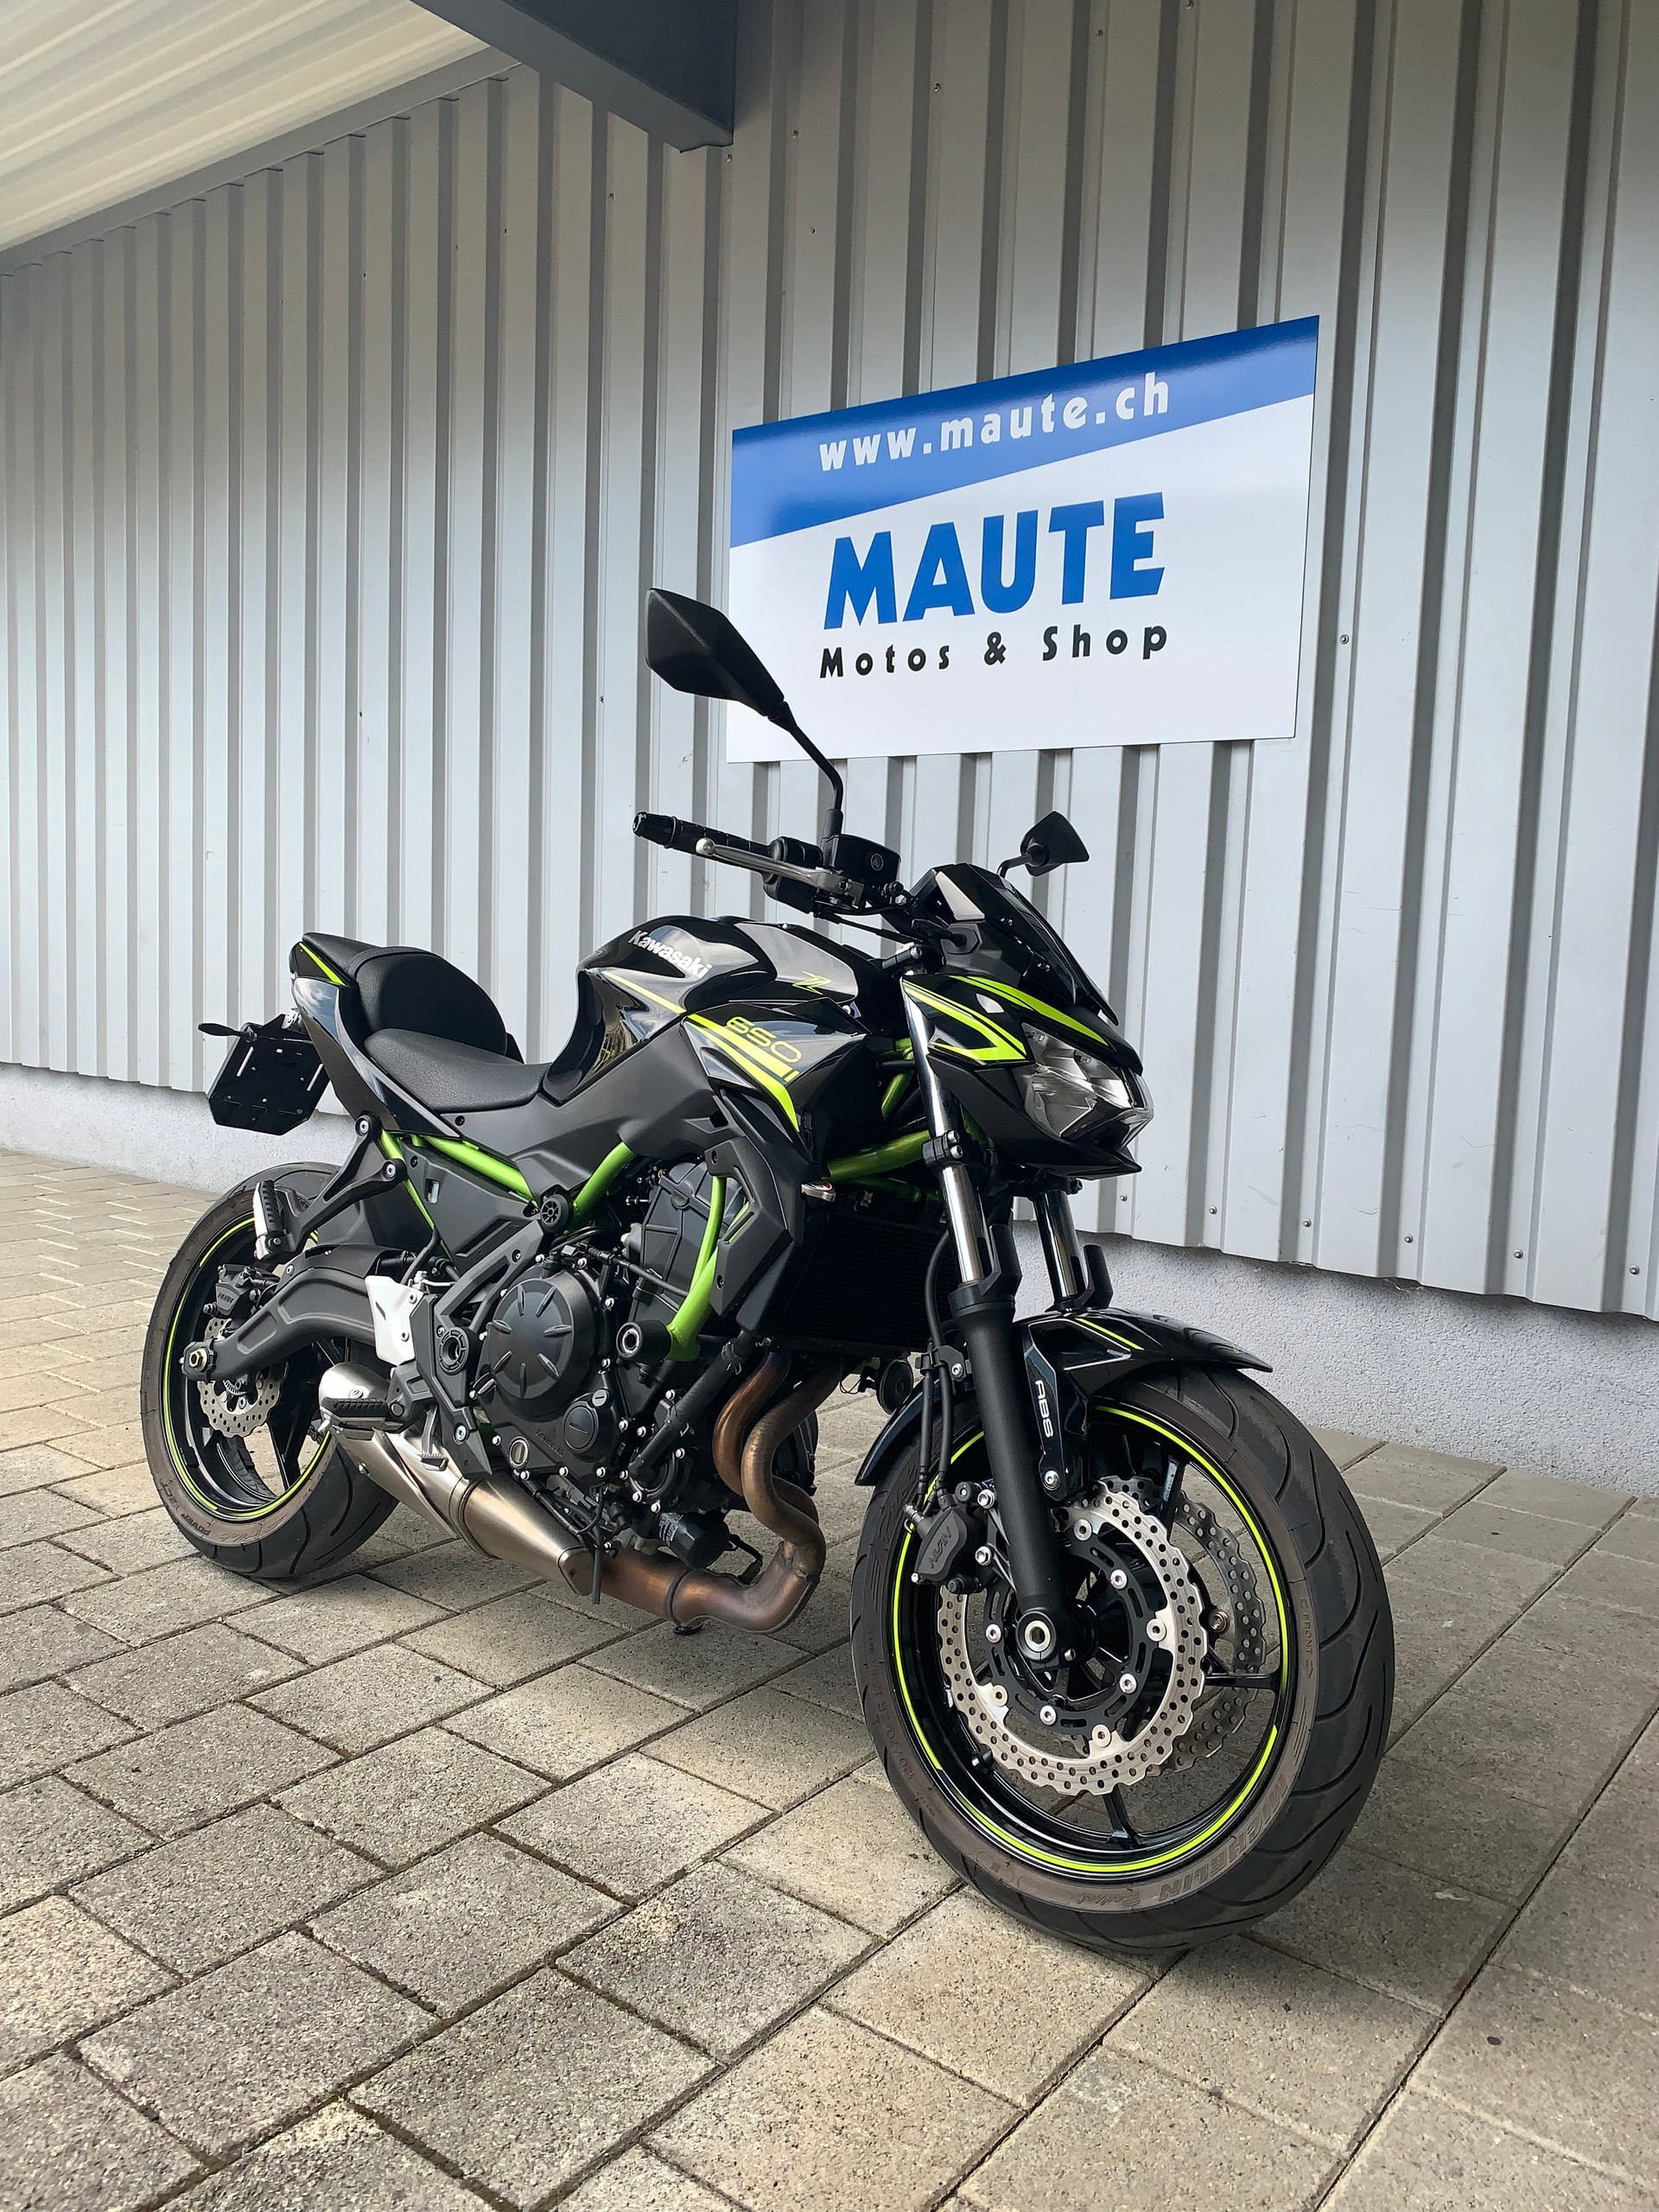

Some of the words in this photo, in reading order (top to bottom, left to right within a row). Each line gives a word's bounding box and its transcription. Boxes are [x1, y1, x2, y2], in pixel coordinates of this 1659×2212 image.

[819, 371, 1168, 472] www.maute.ch
[823, 492, 1166, 630] MAUTE
[818, 645, 950, 679] Motos
[983, 632, 1007, 665] &
[1042, 623, 1167, 661] Shop
[627, 930, 714, 979] Kawasaki
[727, 1016, 802, 1063] 650
[1035, 1380, 1053, 1438] ABS
[1302, 1613, 1313, 1655] FRONT
[1160, 1773, 1288, 1901] MICHELIN
